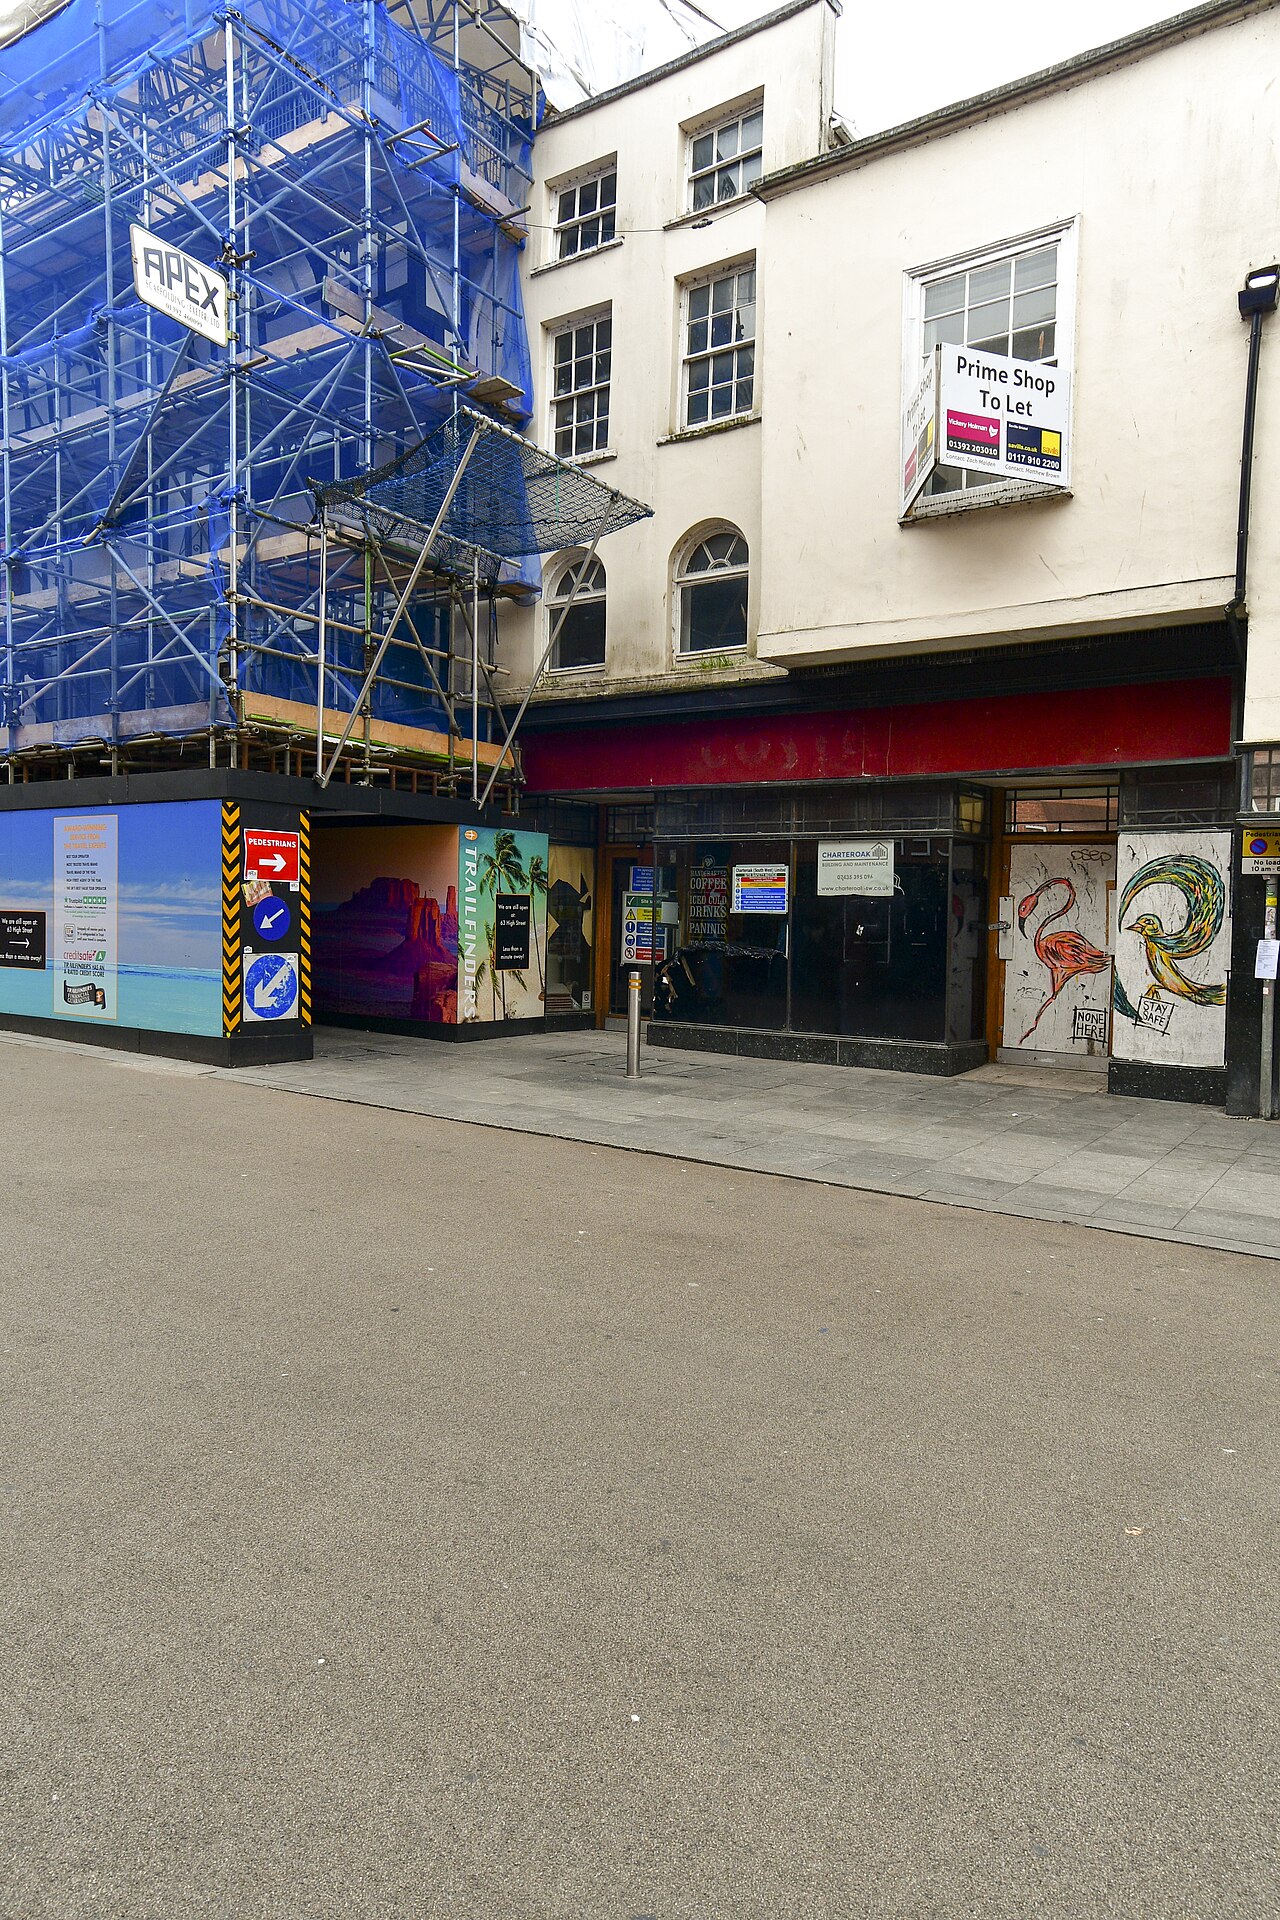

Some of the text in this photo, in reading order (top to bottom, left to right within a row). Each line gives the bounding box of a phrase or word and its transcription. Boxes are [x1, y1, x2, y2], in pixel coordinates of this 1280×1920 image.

[143, 247, 219, 318] APEX
[145, 279, 186, 309] SCAFFOLDING
[210, 317, 220, 329] LTD
[957, 355, 1056, 398] Prime Shop
[979, 389, 1033, 417] To Let
[948, 417, 988, 432] Vickery Holman
[948, 439, 999, 456] 01392 203010
[1008, 443, 1038, 453] savills.co.uk
[1042, 446, 1059, 456] savills
[1007, 452, 1060, 470] 0117 910 2200
[248, 837, 296, 848] PEDESTRIANS
[690, 877, 727, 890] COFFEE
[690, 895, 727, 905] ICED COLD
[690, 905, 727, 918] DRINKS
[1, 917, 8, 925] We
[12, 925, 21, 935] High
[464, 846, 478, 1019] TRAILFINDERS
[690, 922, 727, 935] PANINIS
[5, 951, 14, 960] than
[64, 951, 93, 961] creditsafe
[64, 961, 91, 970] TRAILFINDERS
[92, 970, 105, 978] SCORE
[1143, 1000, 1168, 1016] STAY
[1077, 1011, 1104, 1025] NONE
[1142, 1011, 1166, 1027] SAFE
[1076, 1022, 1104, 1039] HERE
